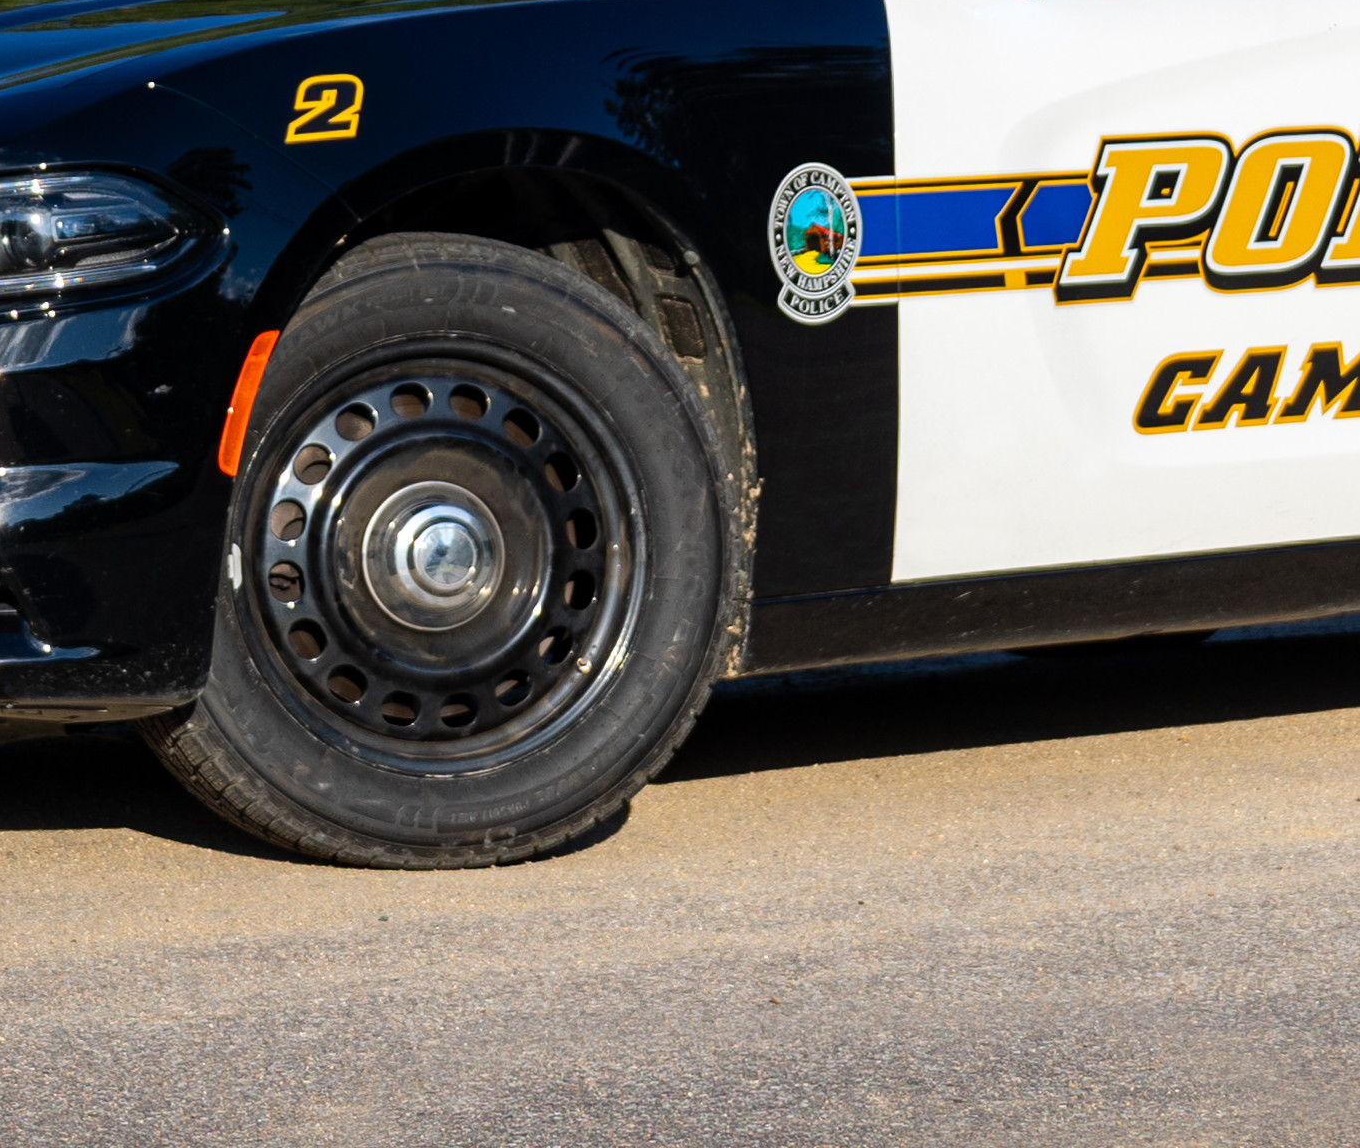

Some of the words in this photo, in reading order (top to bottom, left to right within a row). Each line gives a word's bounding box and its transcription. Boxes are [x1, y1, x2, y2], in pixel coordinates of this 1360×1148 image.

[284, 73, 364, 144] 2
[774, 184, 795, 228] TOWN
[793, 172, 808, 190] OF
[810, 171, 856, 224] CAMPTON
[775, 243, 797, 279] NEW
[797, 237, 856, 291] HAMPSHIRE
[790, 289, 844, 314] POLICE
